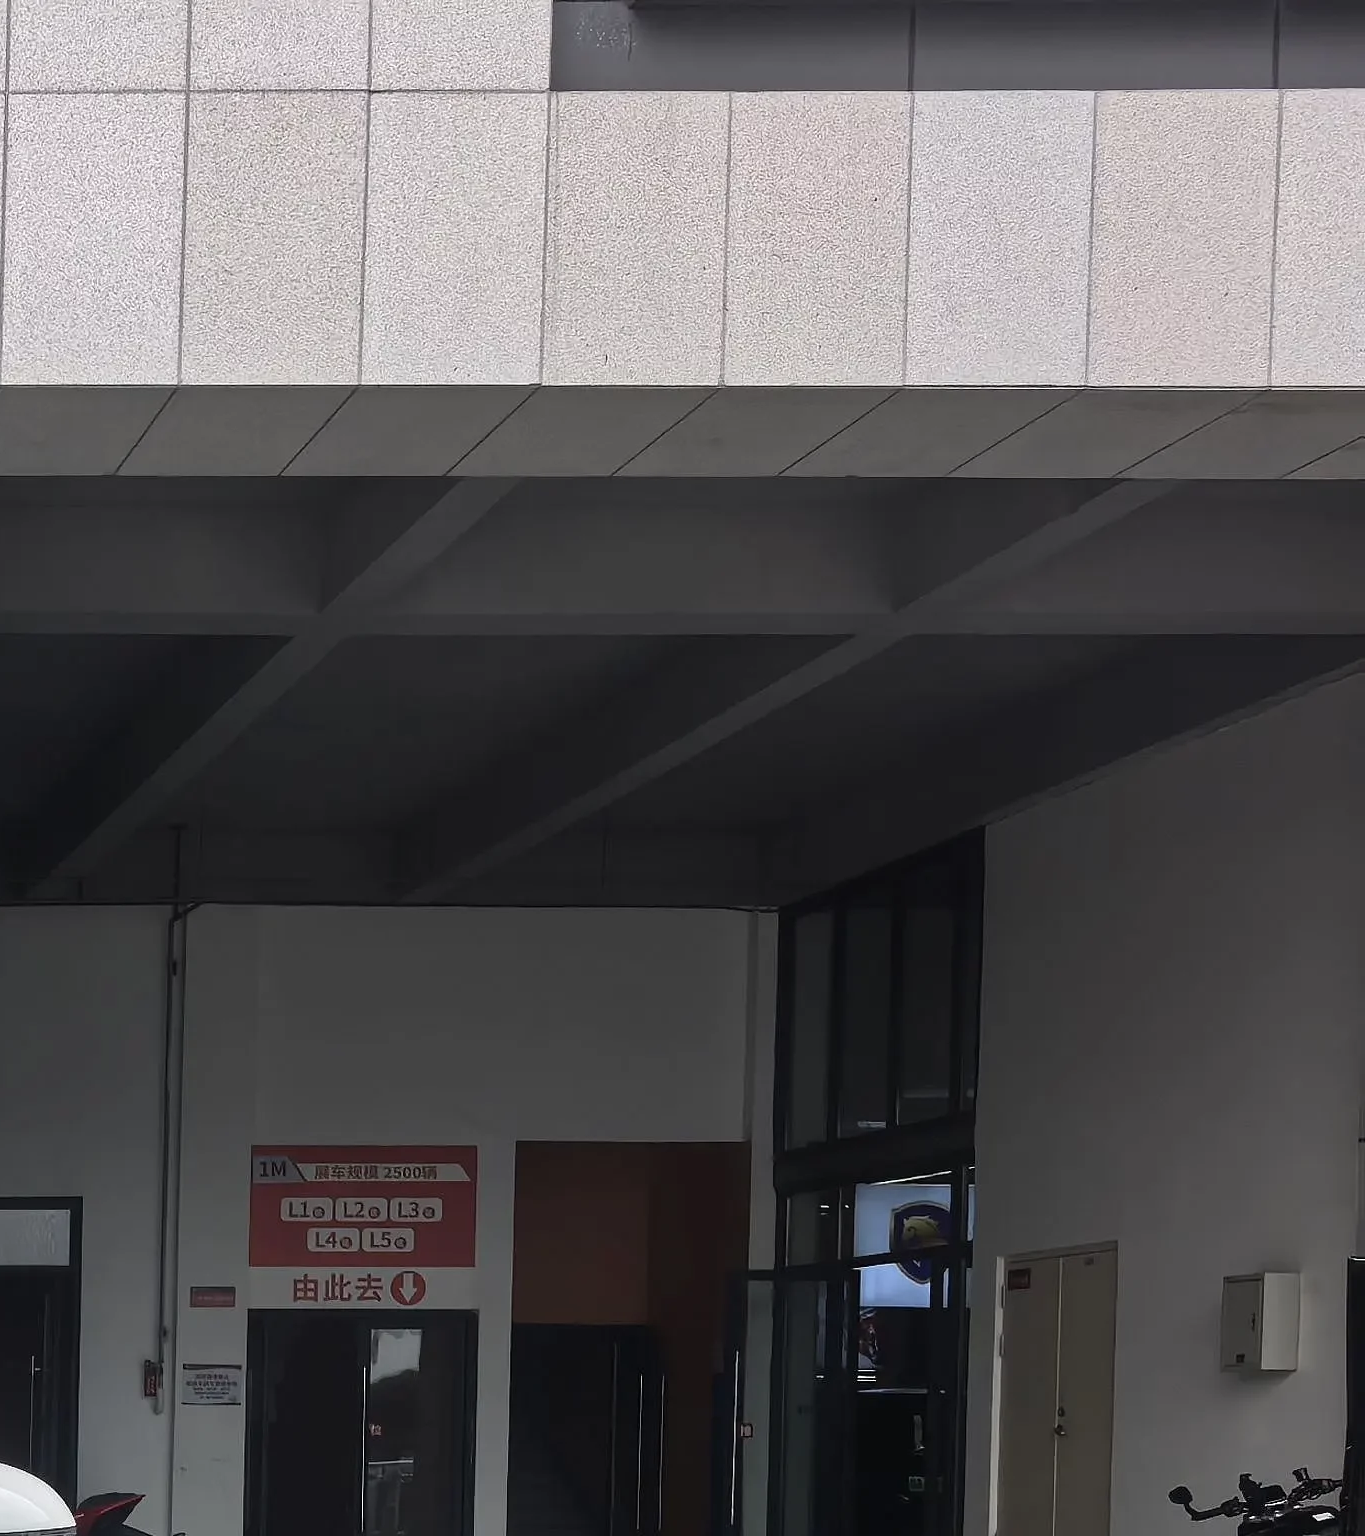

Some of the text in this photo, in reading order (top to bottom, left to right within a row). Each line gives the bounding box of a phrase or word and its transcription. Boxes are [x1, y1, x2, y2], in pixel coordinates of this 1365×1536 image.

[259, 1160, 287, 1178] 1M
[293, 1273, 384, 1303] 由此去
